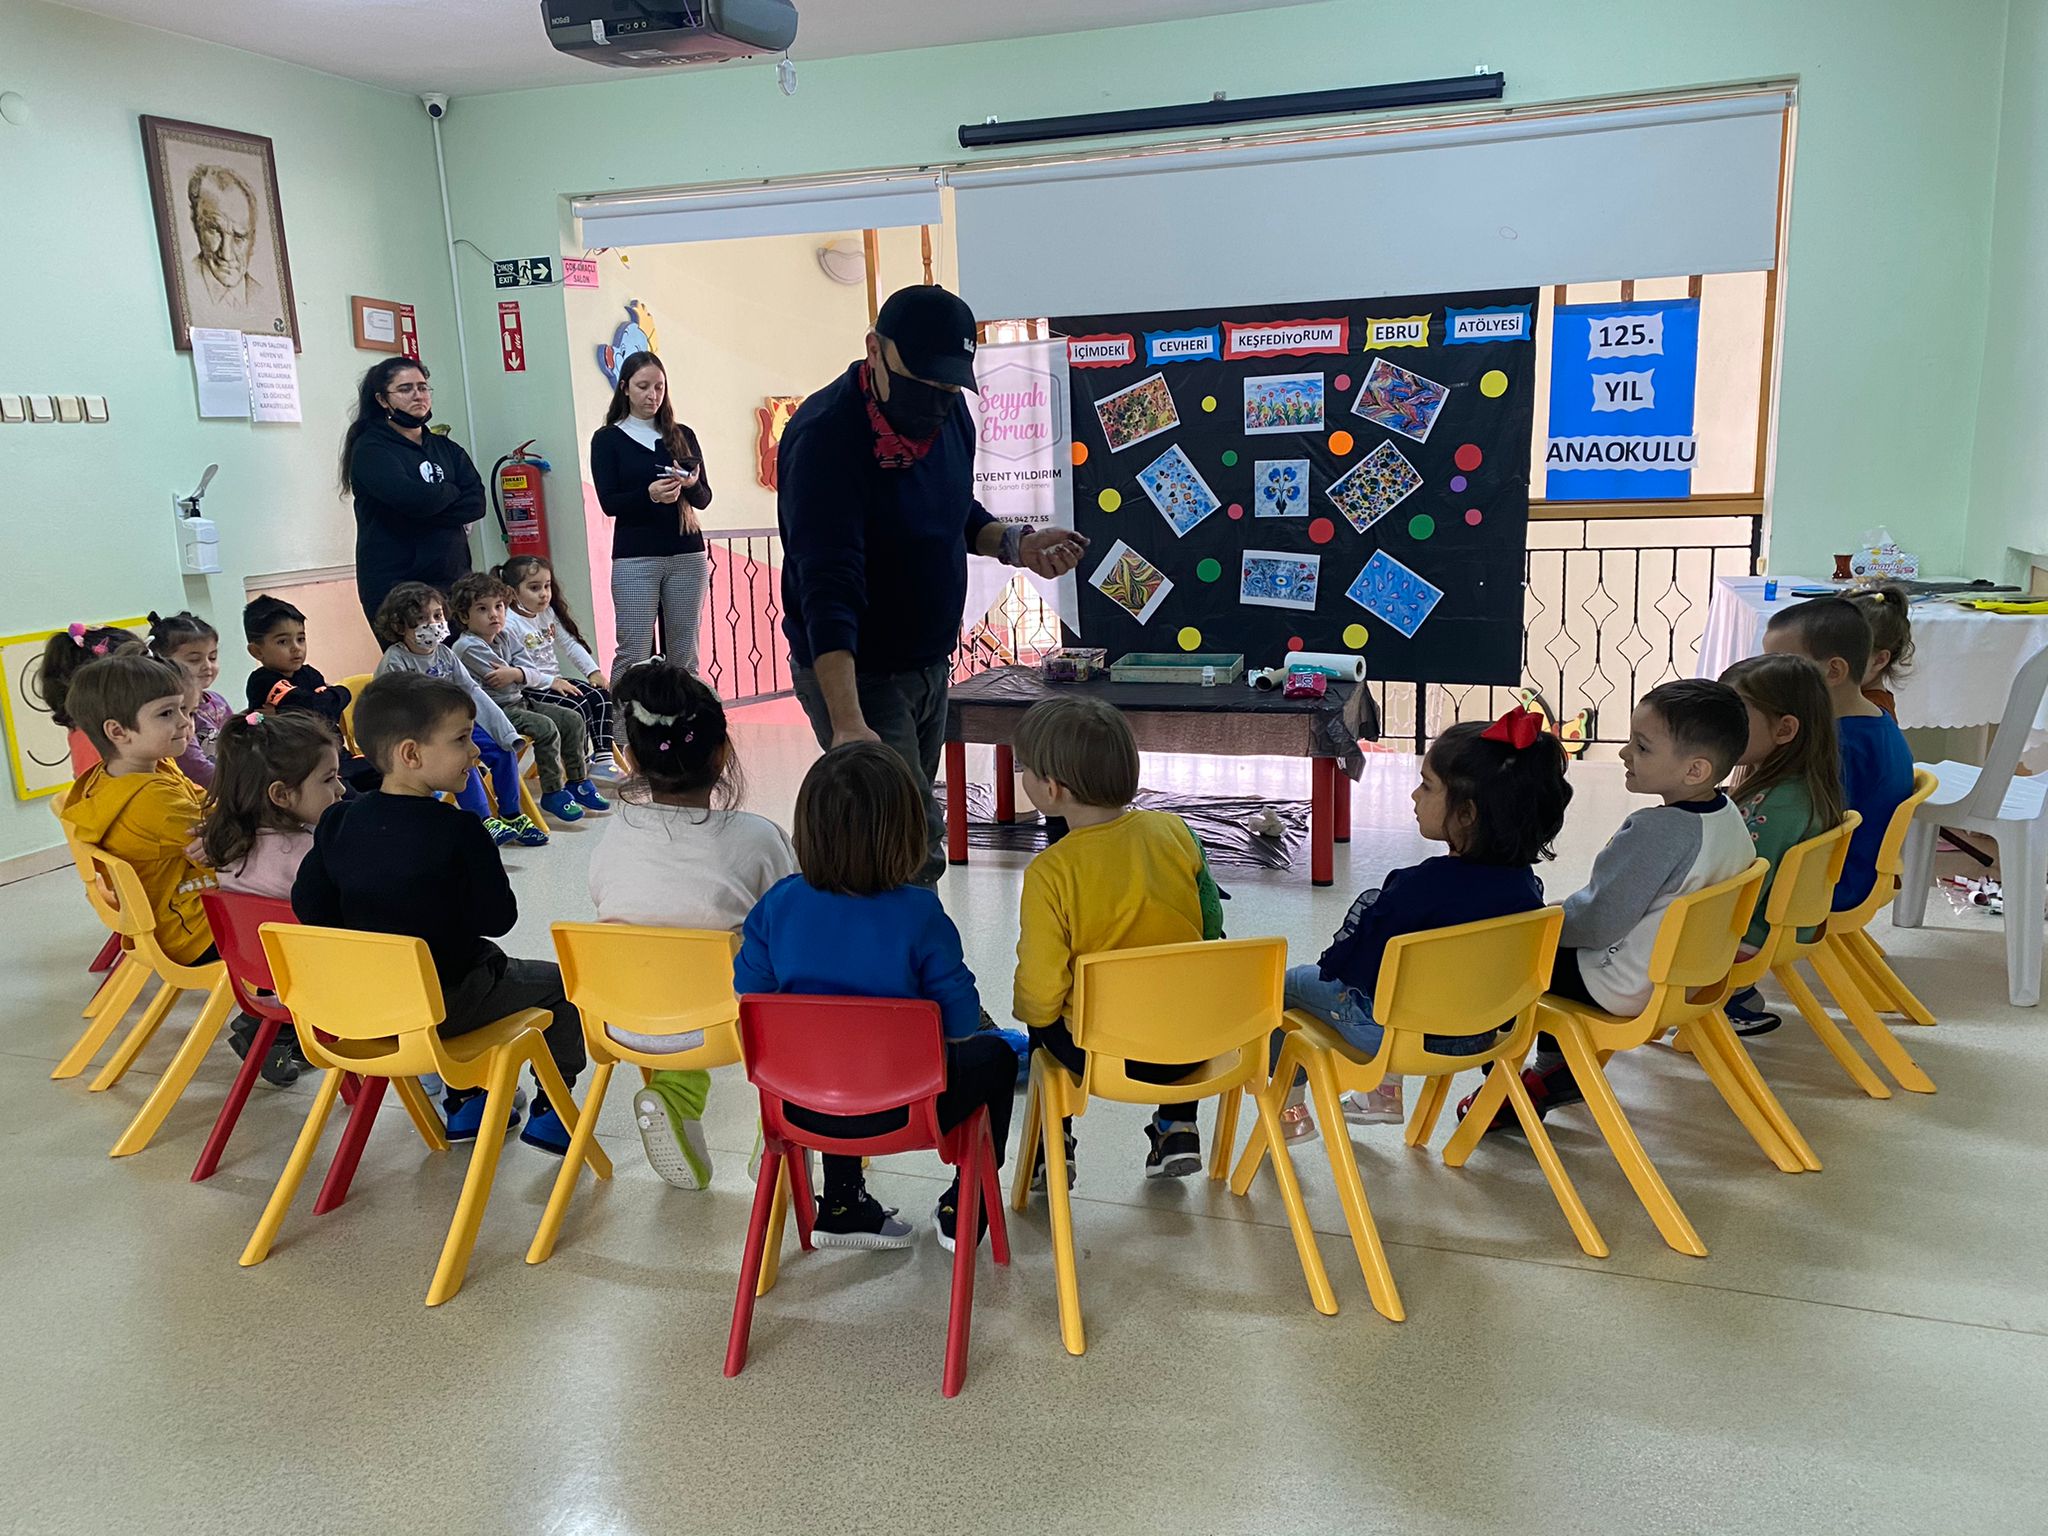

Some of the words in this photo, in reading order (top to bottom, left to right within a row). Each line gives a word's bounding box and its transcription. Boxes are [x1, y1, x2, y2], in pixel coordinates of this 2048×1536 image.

[499, 276, 513, 284] EXIT
[1074, 342, 1125, 359] İÇİMDEKİ
[1159, 337, 1207, 352] CEVHERİ
[1238, 330, 1333, 348] KEŞFEDİYORUM
[1375, 325, 1420, 340] EBRU
[1458, 316, 1520, 333] ATÖLYESİ
[1599, 324, 1654, 347] 125.
[978, 382, 1047, 420] Seyyah
[1605, 381, 1643, 402] YIL
[981, 416, 1048, 443] Ebrucu
[1546, 442, 1696, 462] ANAOKULU
[975, 472, 1011, 481] EVENT
[1014, 469, 1062, 480] YILDIRIM
[1030, 515, 1039, 523] 72
